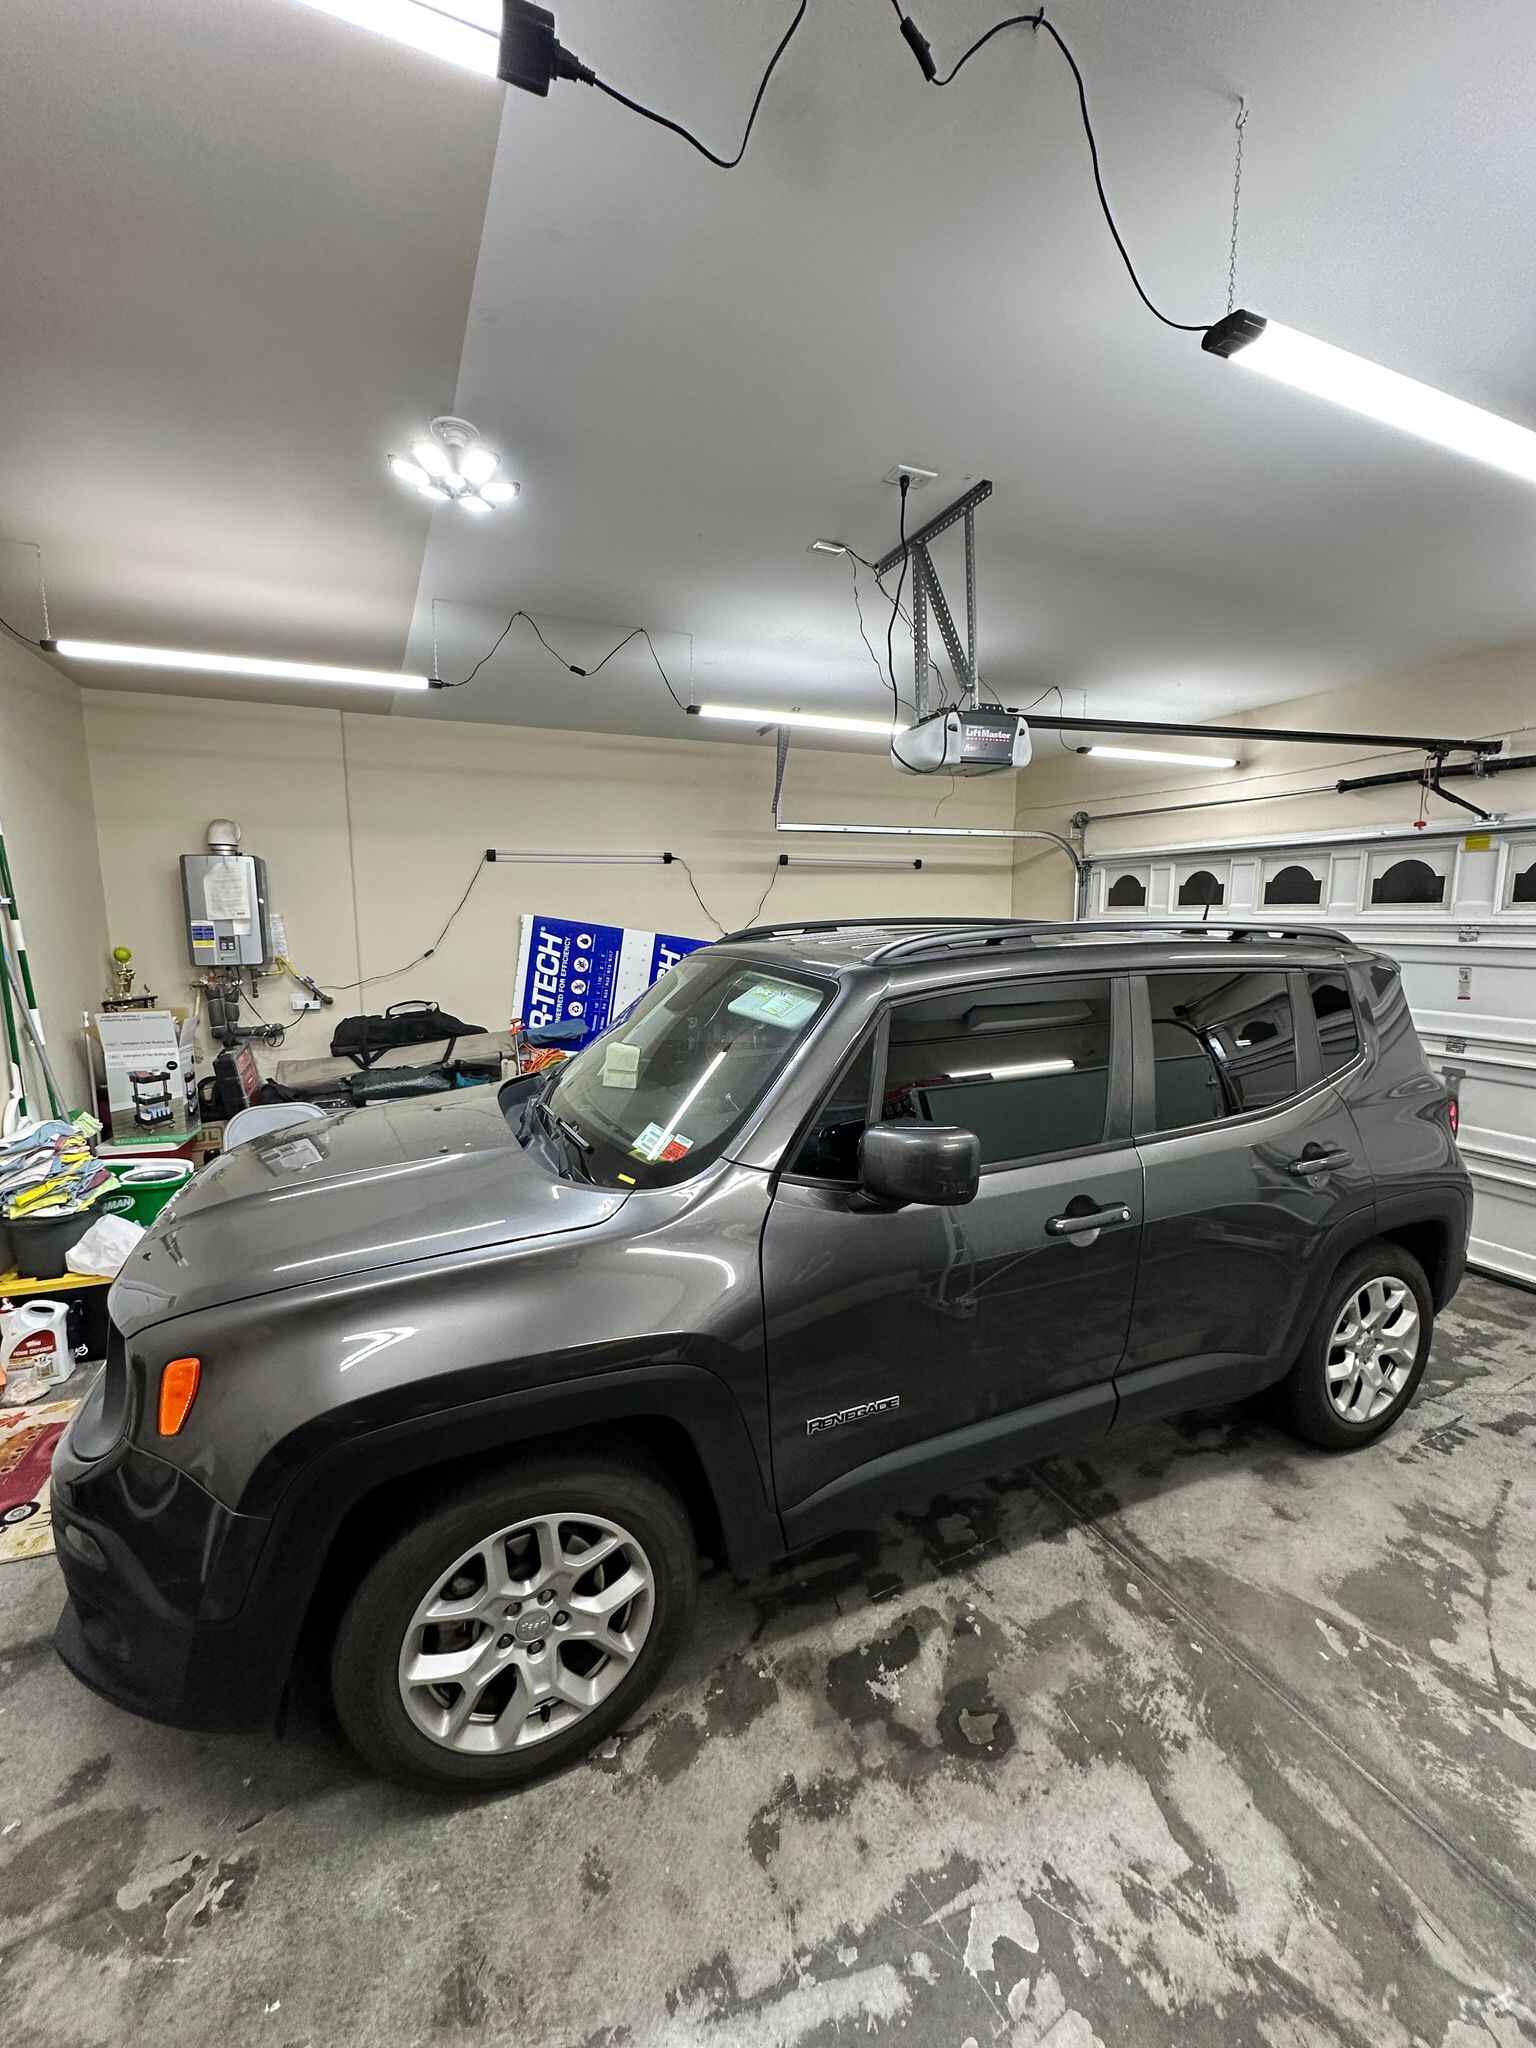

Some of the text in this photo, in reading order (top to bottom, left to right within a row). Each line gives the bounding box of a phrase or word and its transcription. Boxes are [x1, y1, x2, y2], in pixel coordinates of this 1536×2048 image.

[966, 727, 1011, 739] LiftMaster
[555, 936, 572, 1024] NEERED FOR EFFICIENCY
[806, 1395, 900, 1435] RENEGADE
